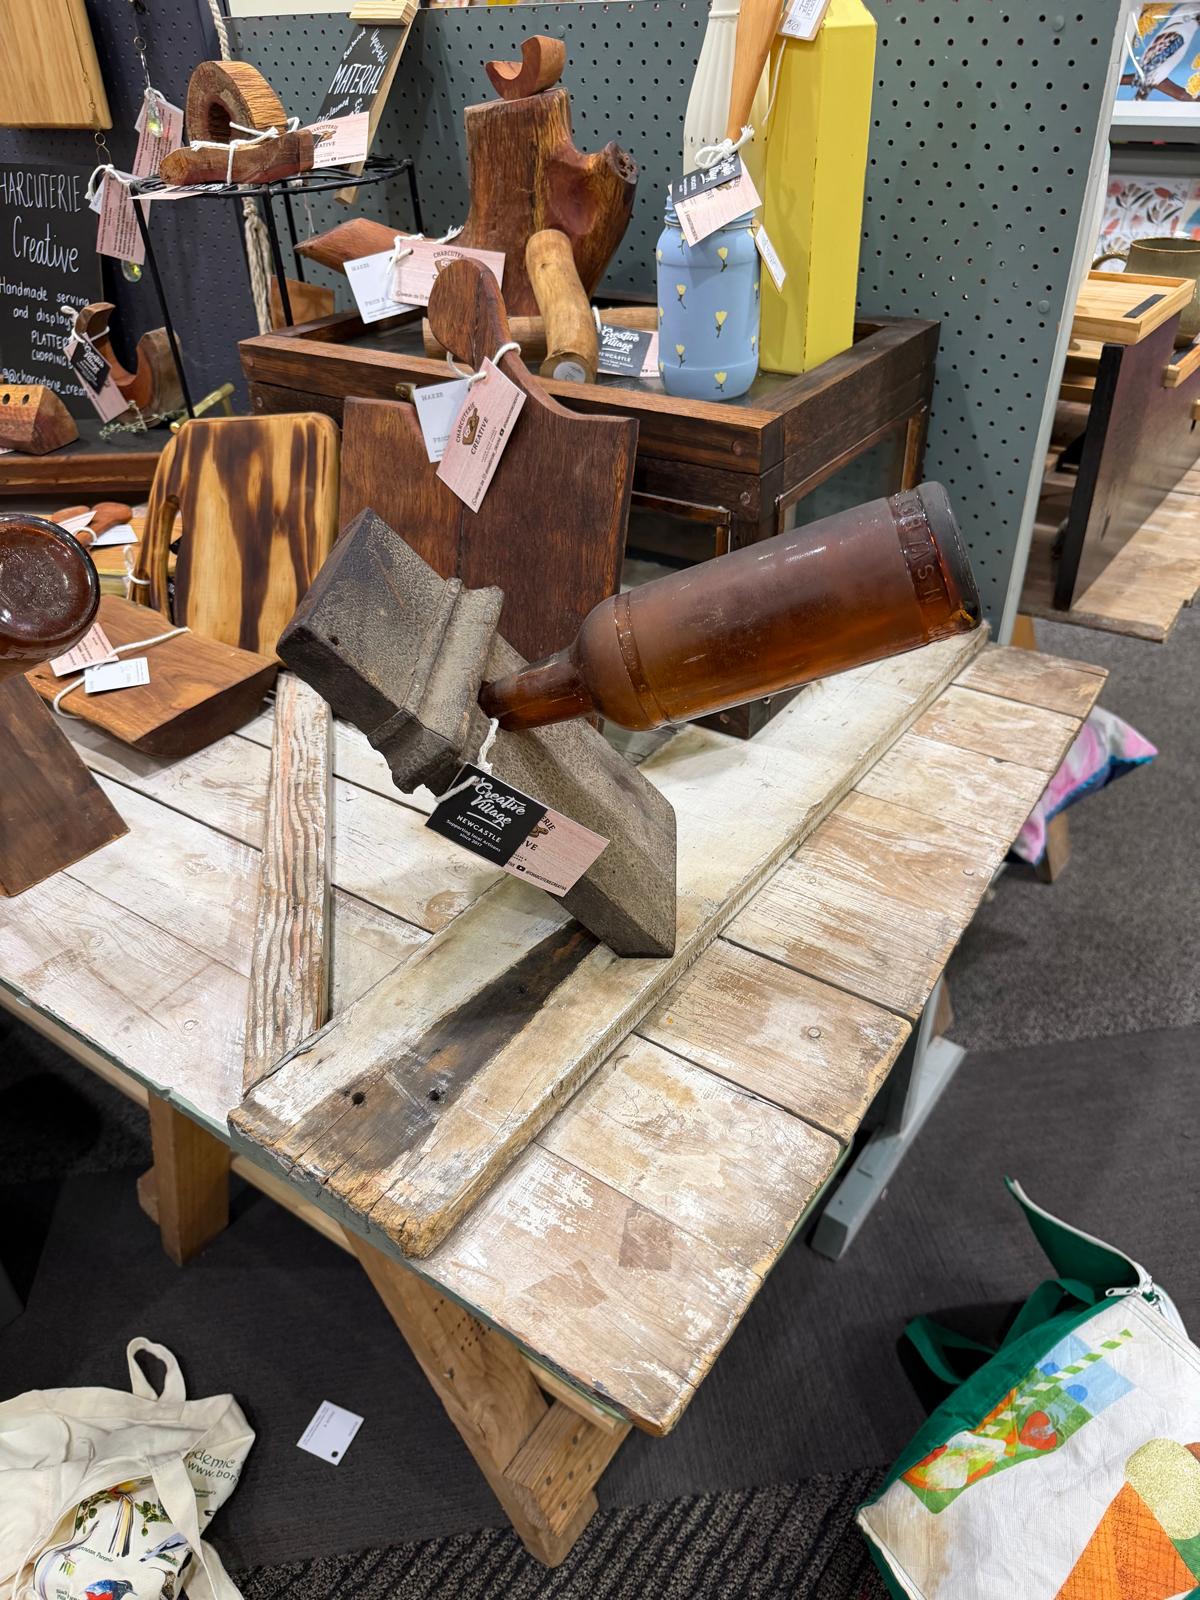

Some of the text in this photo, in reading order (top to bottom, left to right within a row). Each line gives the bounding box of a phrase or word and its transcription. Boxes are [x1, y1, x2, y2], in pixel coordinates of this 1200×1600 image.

[328, 63, 385, 95] MATERIAL
[13, 215, 79, 274] Creative
[0, 276, 48, 301] Handmade
[13, 305, 29, 319] and
[471, 416, 489, 455] CREATIVE
[470, 795, 513, 828] Village
[475, 777, 527, 816] Creative
[456, 814, 502, 843] NEWCASTLE
